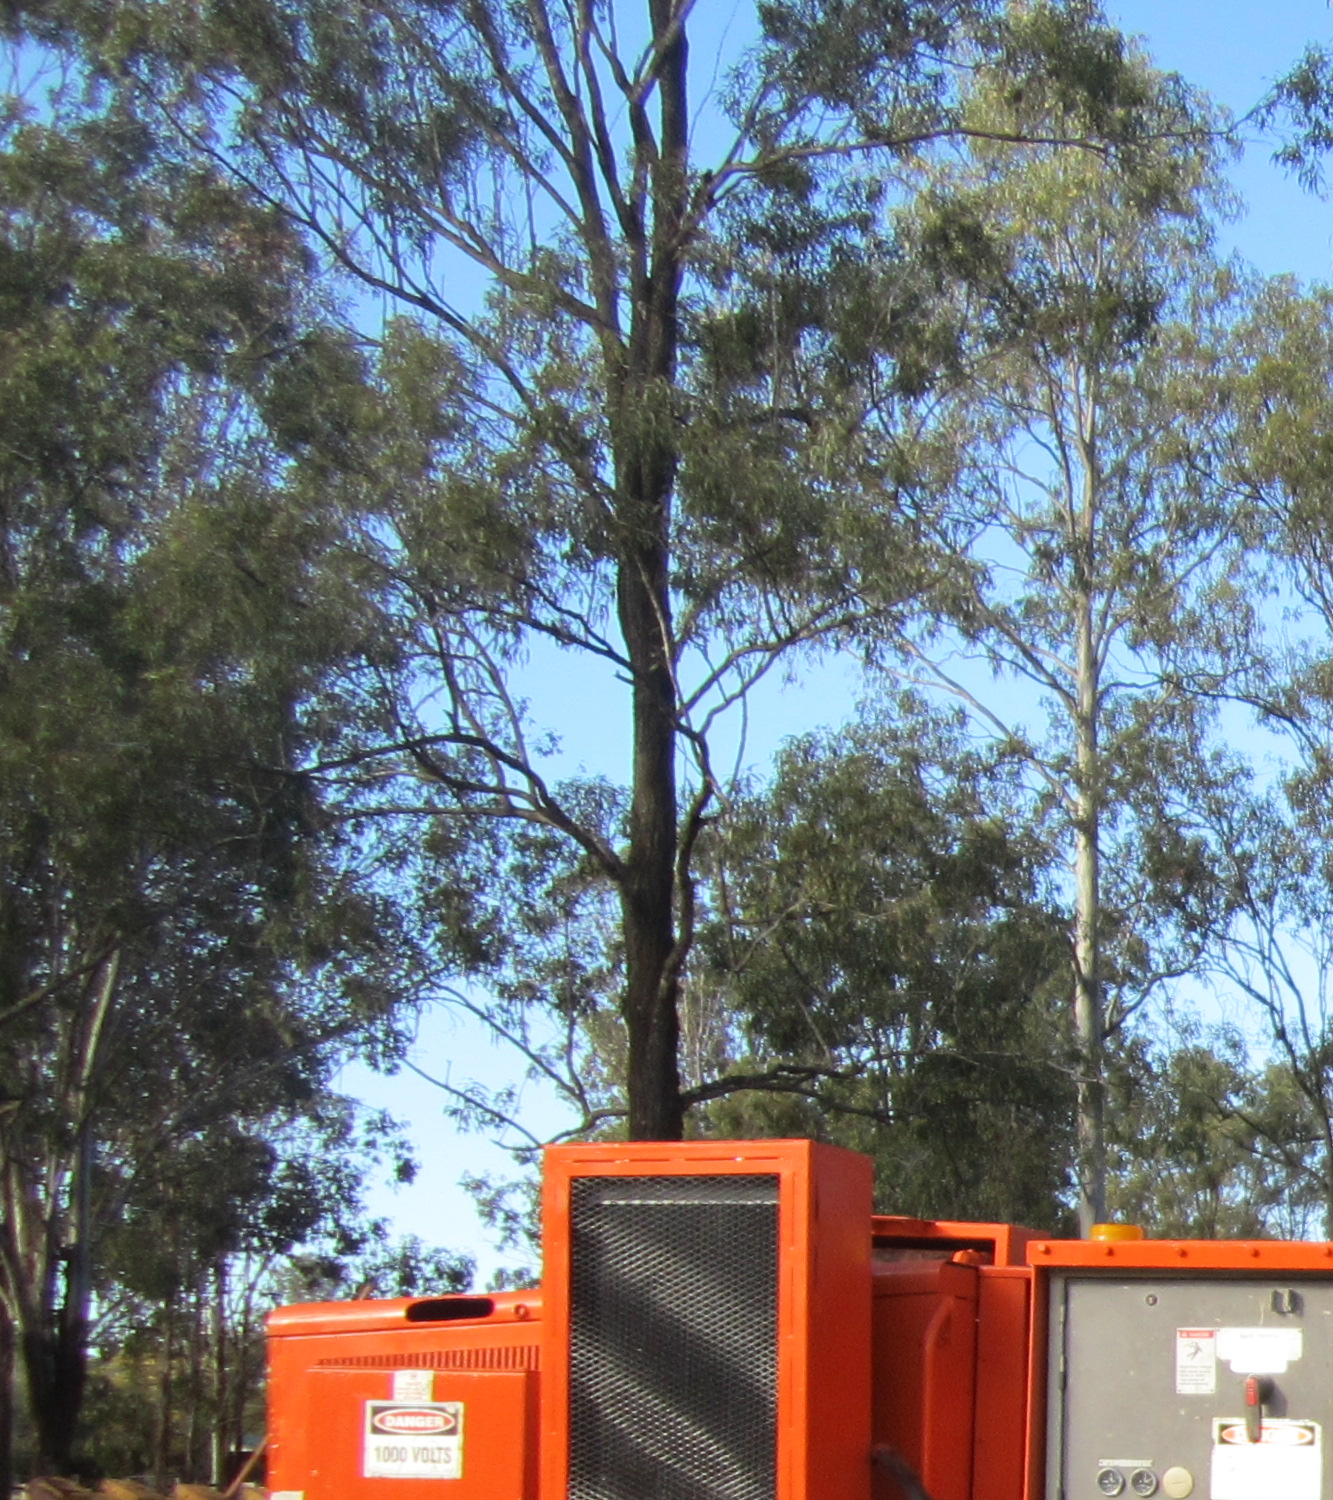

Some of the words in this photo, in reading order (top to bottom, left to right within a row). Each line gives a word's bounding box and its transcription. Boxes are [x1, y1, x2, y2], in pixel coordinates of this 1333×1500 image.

[384, 1415, 445, 1428] DANGER
[374, 1446, 408, 1463] 1000
[411, 1446, 453, 1464] VOLTS
